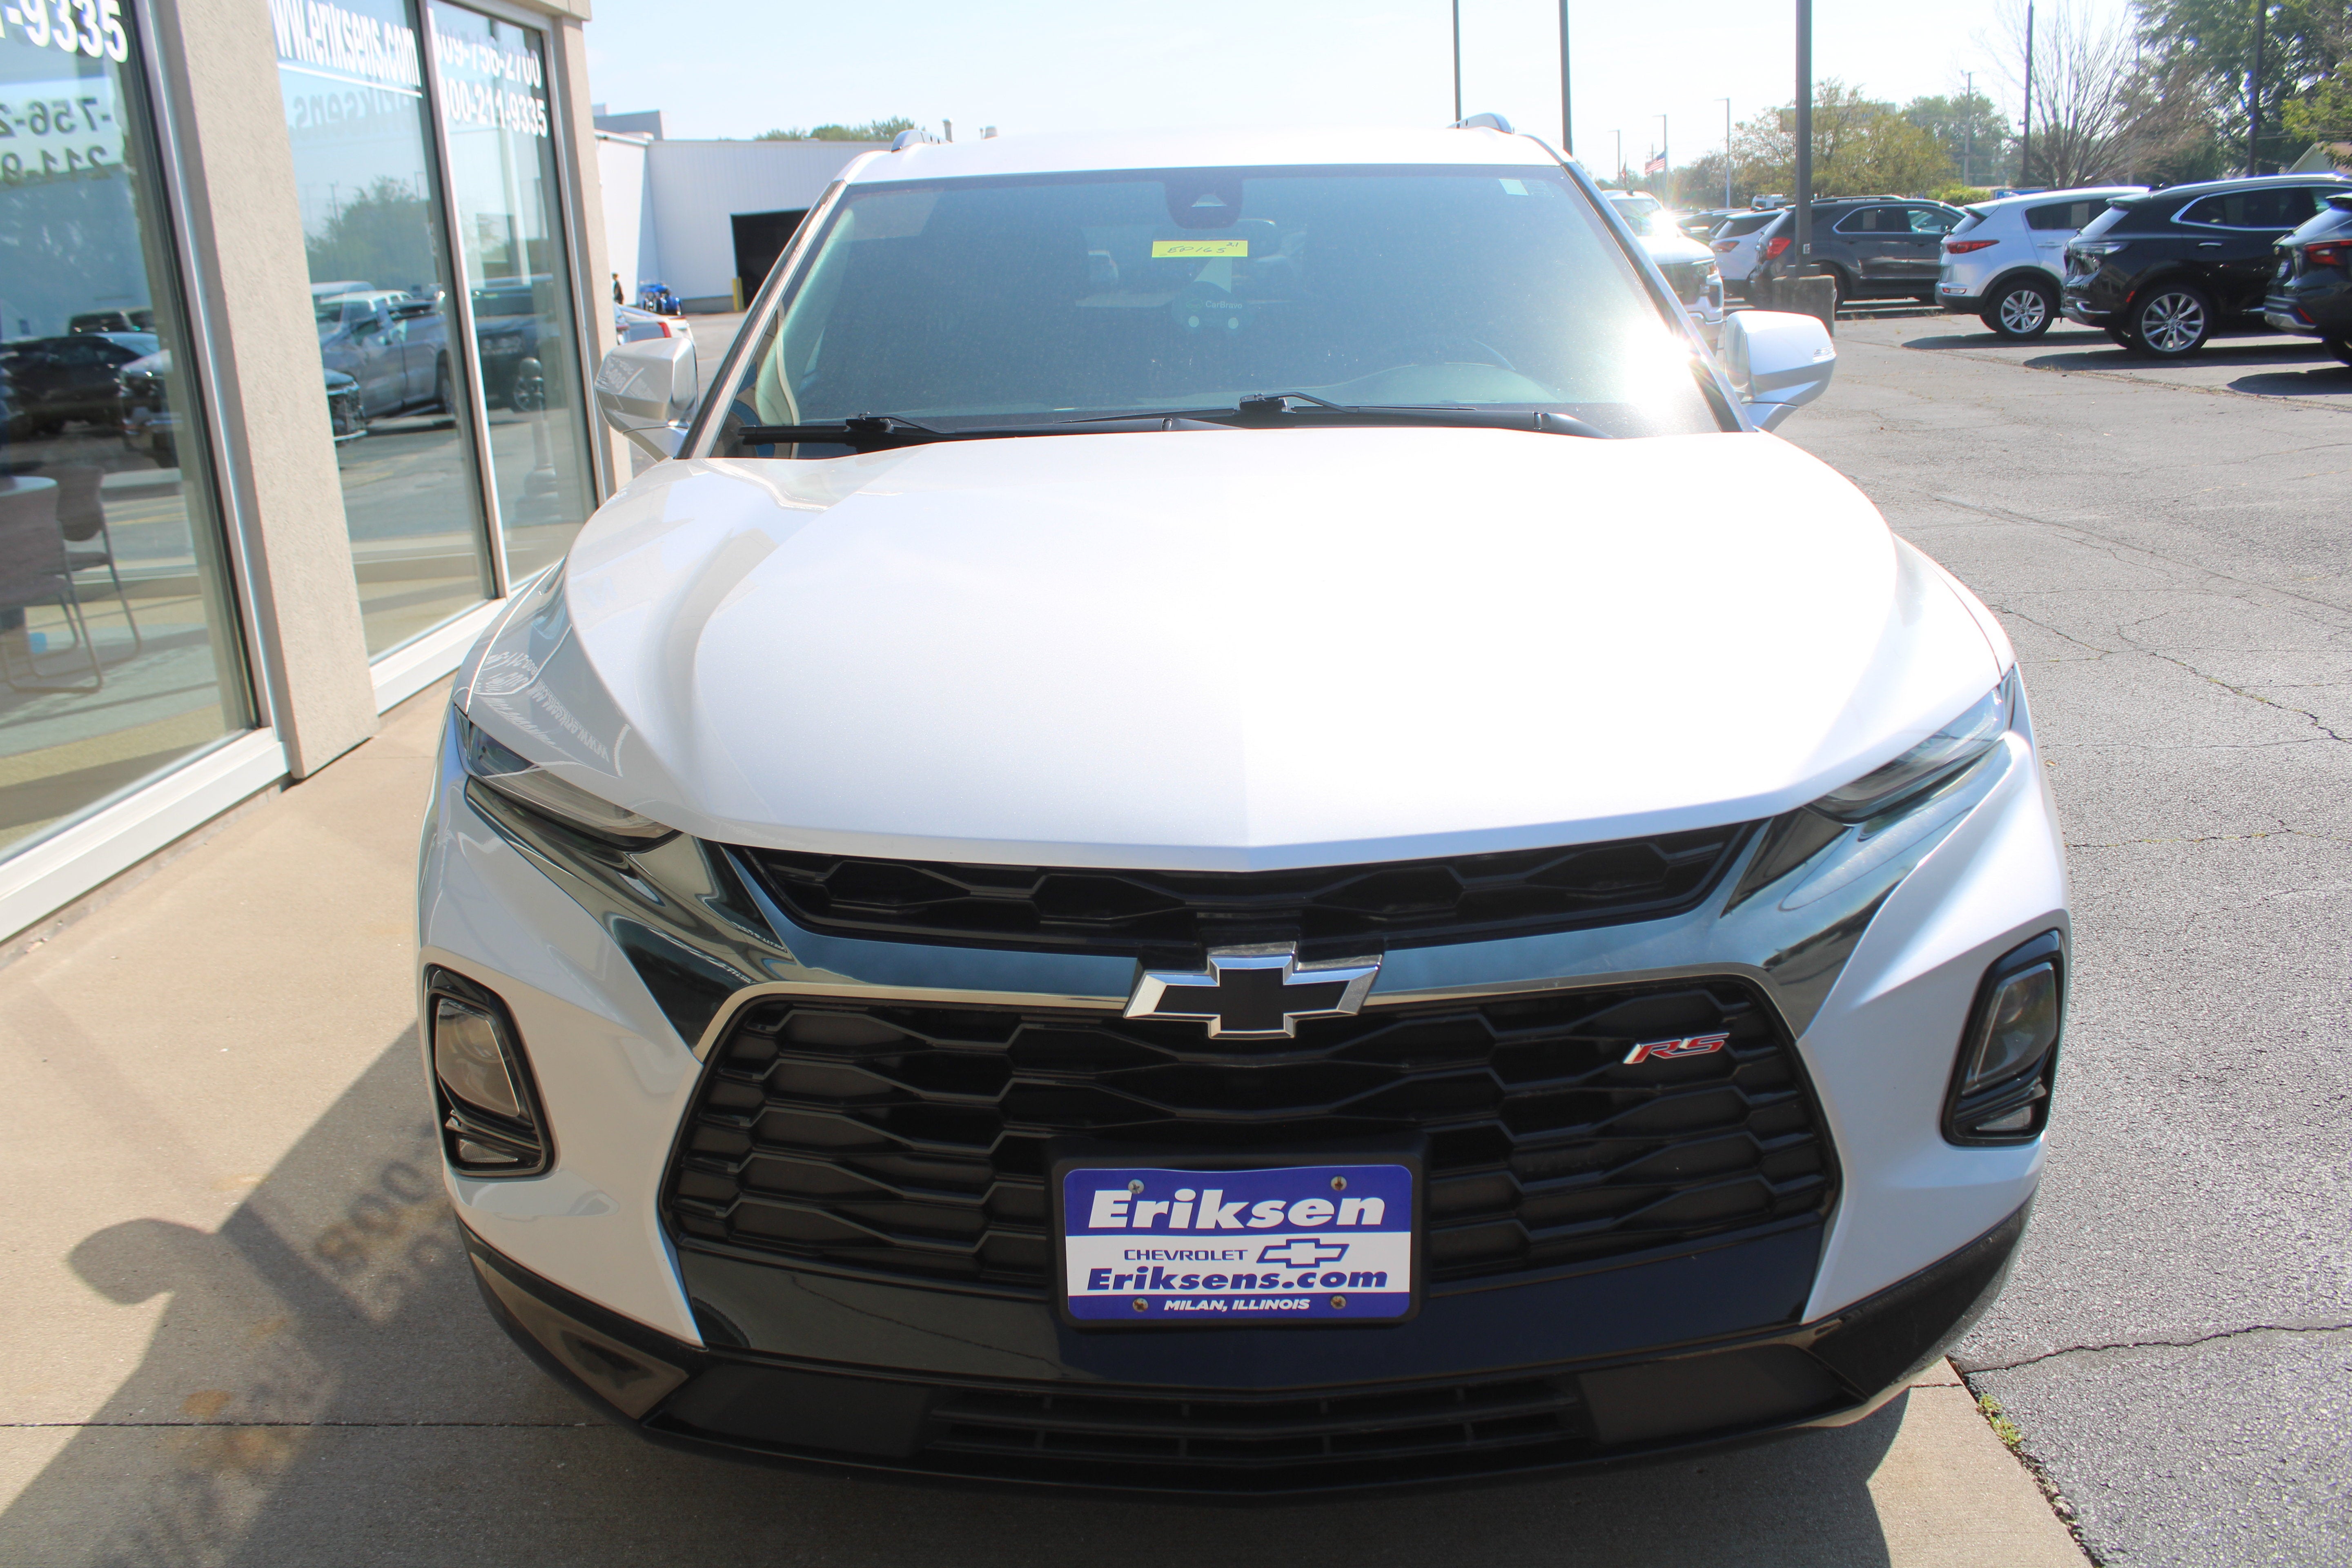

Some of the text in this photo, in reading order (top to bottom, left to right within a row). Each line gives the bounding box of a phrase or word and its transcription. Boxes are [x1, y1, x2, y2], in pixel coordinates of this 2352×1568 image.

[0, 0, 128, 62] -9335
[1205, 300, 1243, 309] CarBravo
[1623, 1032, 1730, 1064] RS
[1088, 1188, 1385, 1229] Eriksen
[1124, 1249, 1248, 1261] CHEVROLET
[1087, 1266, 1388, 1291] Eriksens.com
[1164, 1298, 1310, 1312] MILAN, ILLINOIS
